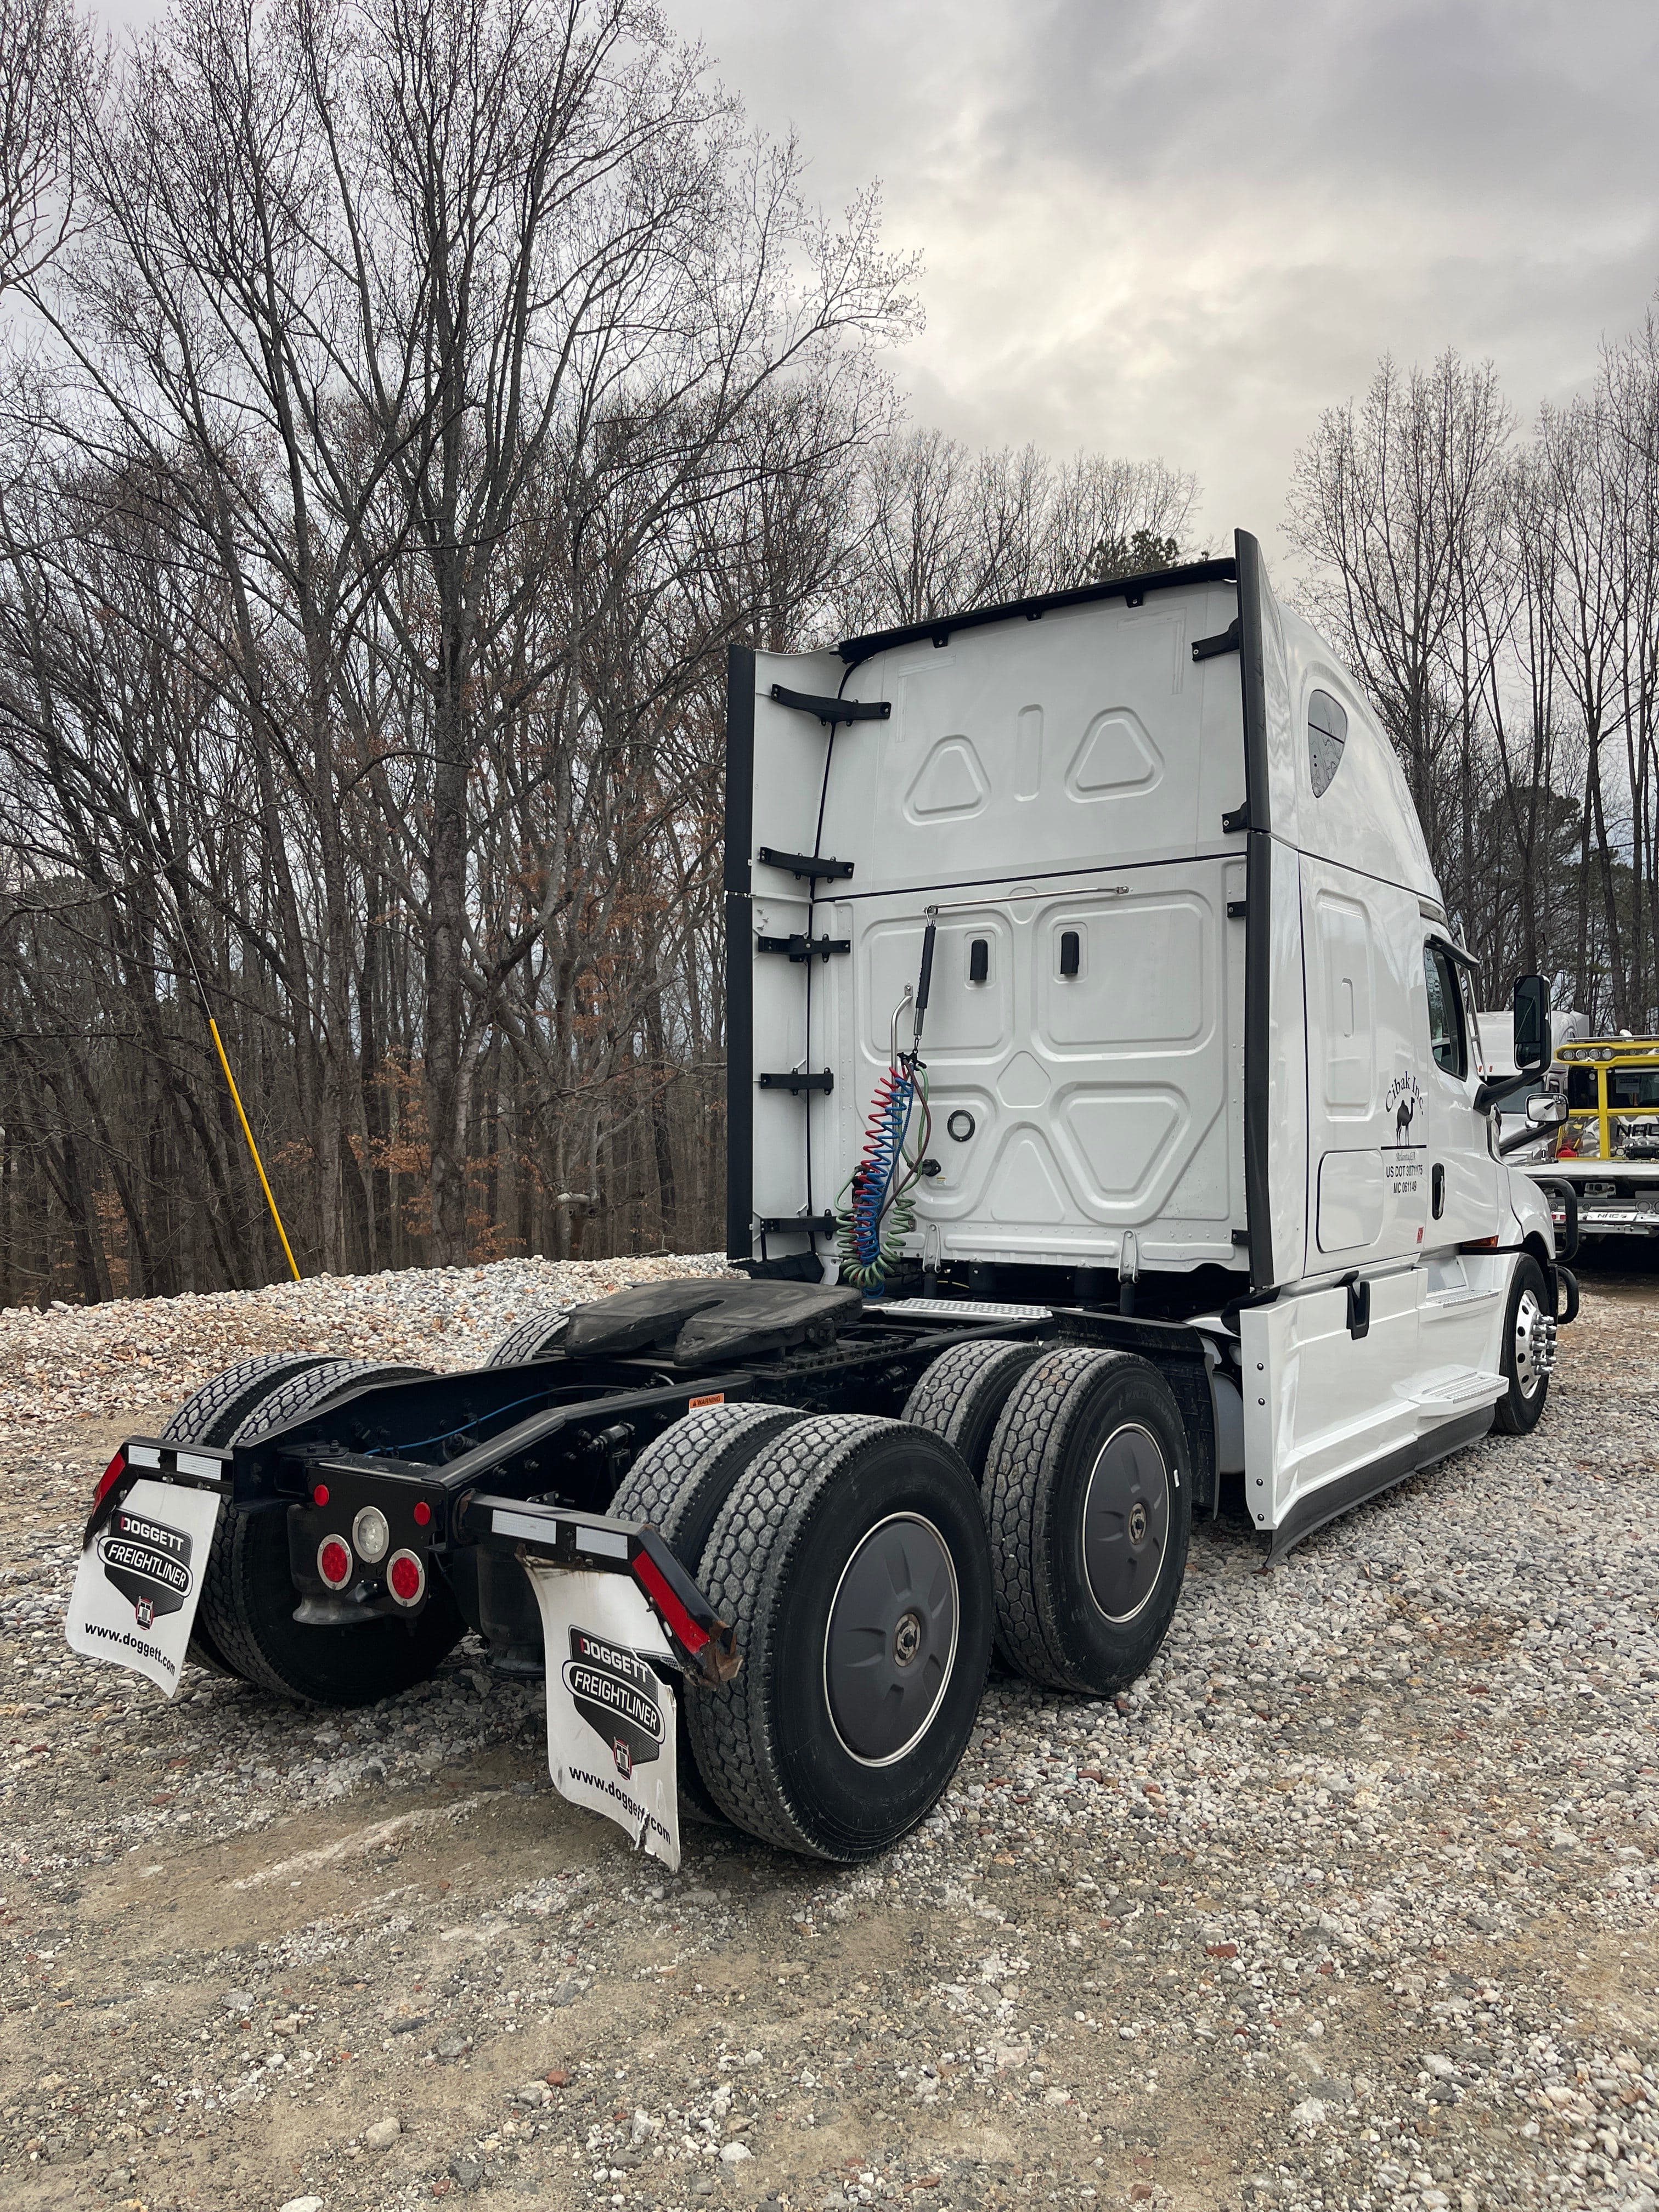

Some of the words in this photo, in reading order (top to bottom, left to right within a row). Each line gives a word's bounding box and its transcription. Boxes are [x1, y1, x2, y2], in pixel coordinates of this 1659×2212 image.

[1385, 1071, 1410, 1113] Cibak
[1386, 1166, 1394, 1178] US
[1395, 1165, 1406, 1177] DOT
[1393, 1182, 1401, 1194] MC
[697, 1396, 720, 1405] WARNING
[120, 1516, 184, 1552] DOGGETT
[108, 1544, 187, 1588] FREIGHTLINER
[85, 1623, 176, 1676] www.doggett.com
[580, 1637, 648, 1683] DOGGETT
[574, 1671, 657, 1730] FREIGHTLINER
[568, 1767, 671, 1846] www.doggettcom
